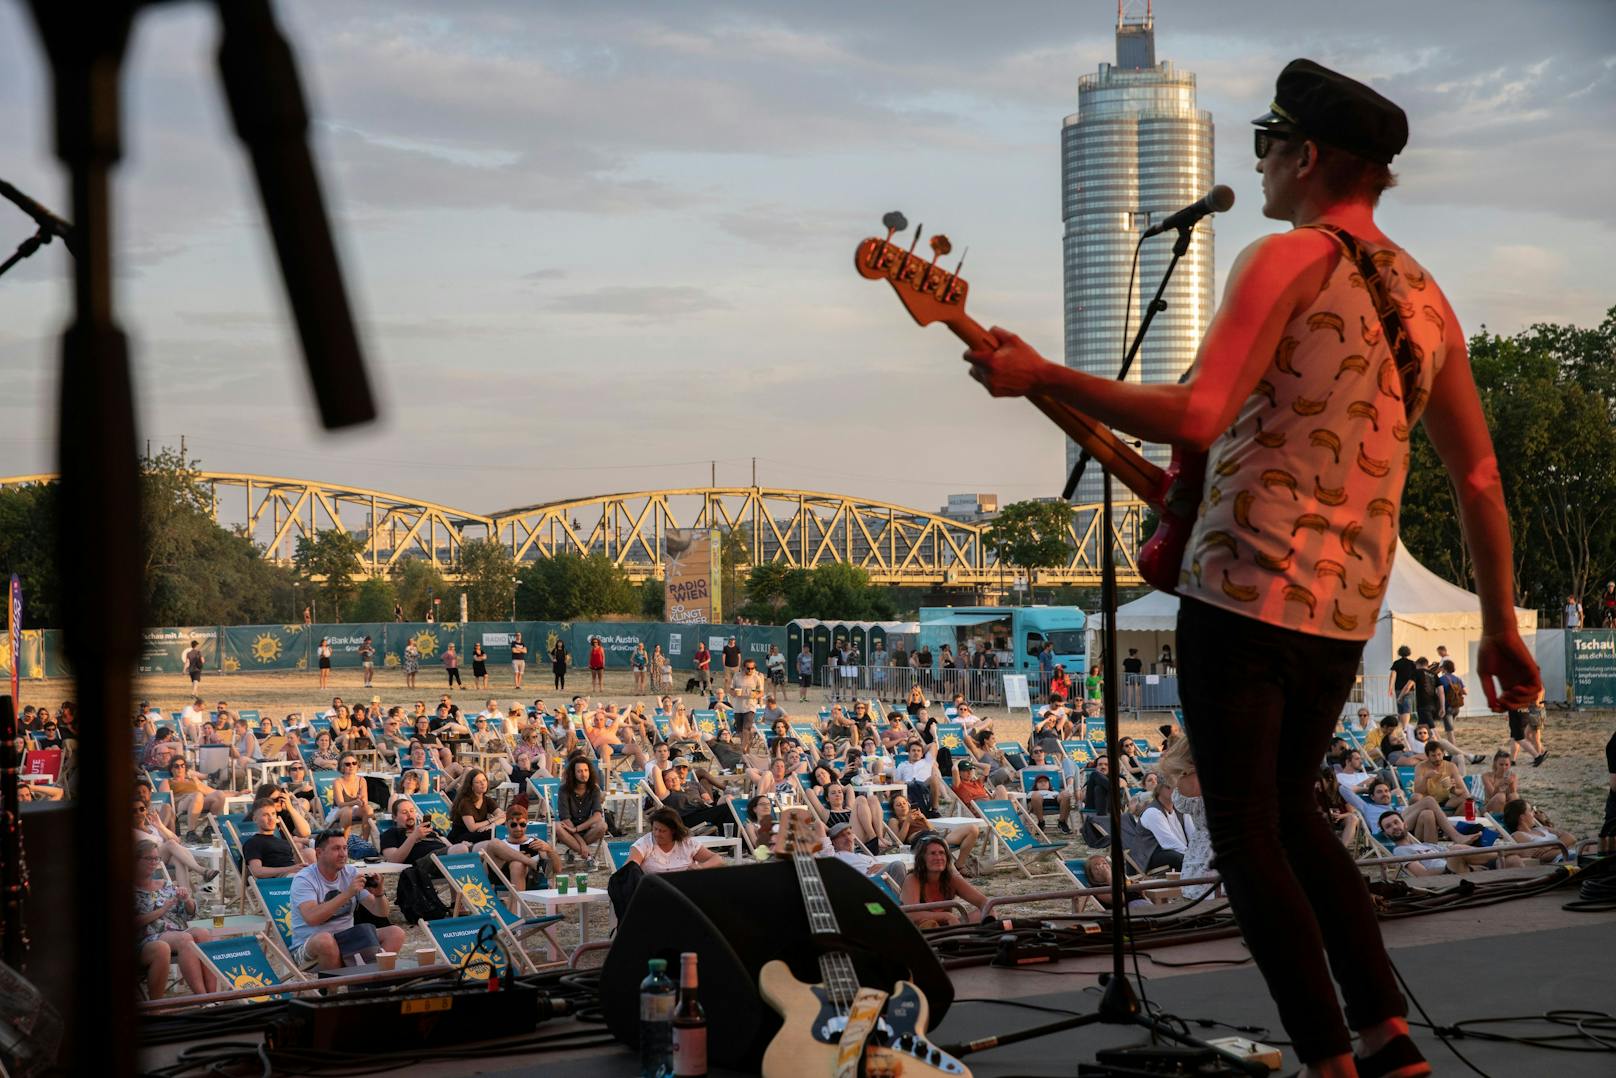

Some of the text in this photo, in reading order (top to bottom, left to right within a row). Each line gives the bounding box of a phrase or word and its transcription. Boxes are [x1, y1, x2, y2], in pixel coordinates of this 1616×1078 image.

[669, 579, 706, 593] RADIO
[674, 588, 707, 603] WIEN
[671, 604, 685, 614] SO
[669, 608, 703, 622] KLINGT
[144, 632, 164, 640] schau
[164, 632, 177, 640] mit
[331, 636, 349, 645] Bank
[615, 634, 640, 644] Austria
[1574, 638, 1614, 650] Tschau
[1589, 652, 1603, 660] dich
[212, 950, 252, 961] KULTURSOMMER
